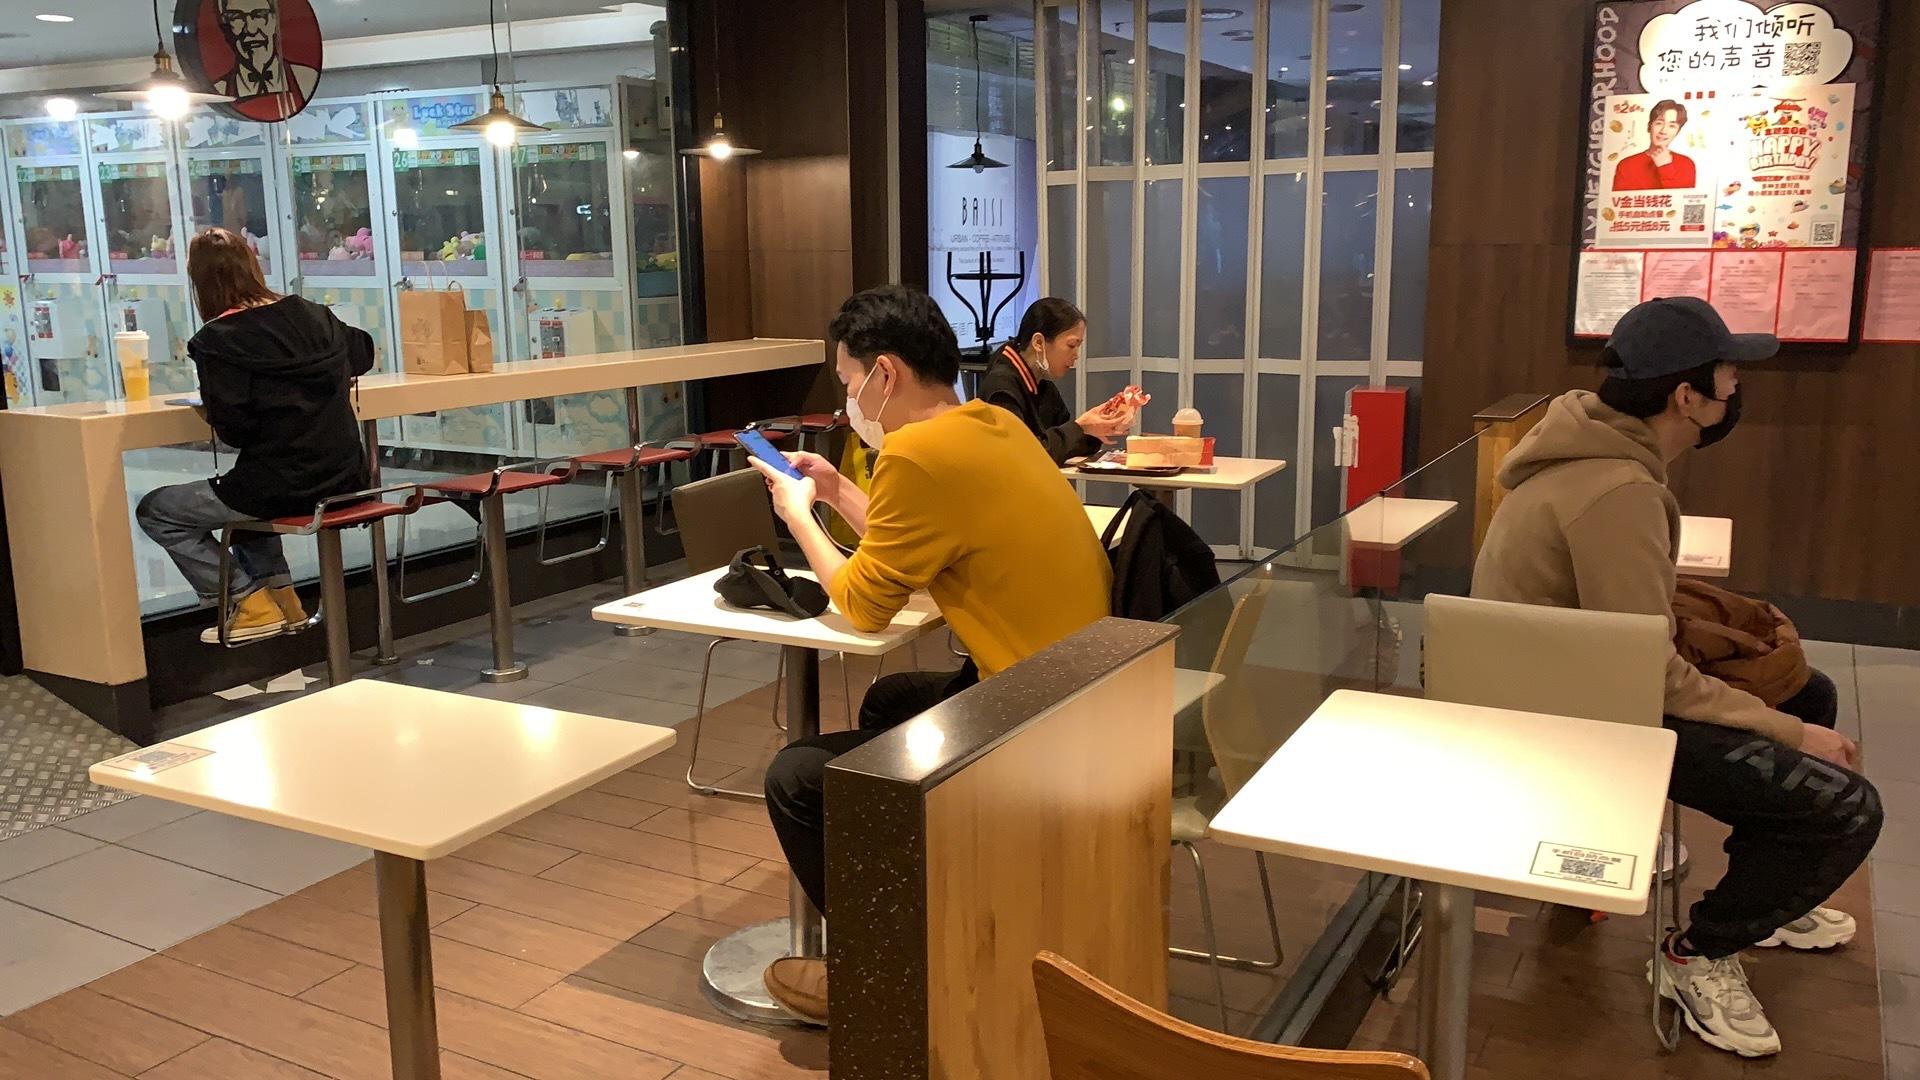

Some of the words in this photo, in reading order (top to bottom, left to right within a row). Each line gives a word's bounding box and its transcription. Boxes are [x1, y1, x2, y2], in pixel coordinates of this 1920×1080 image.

[1694, 13, 1815, 41] 我们倾听
[1658, 42, 1775, 72] 您的声音
[1750, 135, 1822, 157] HAPPY
[394, 152, 408, 168] 26
[1749, 153, 1817, 171] BIRTHDAY
[1612, 195, 1672, 208] V金当钱花
[1691, 981, 1702, 998] FILA
